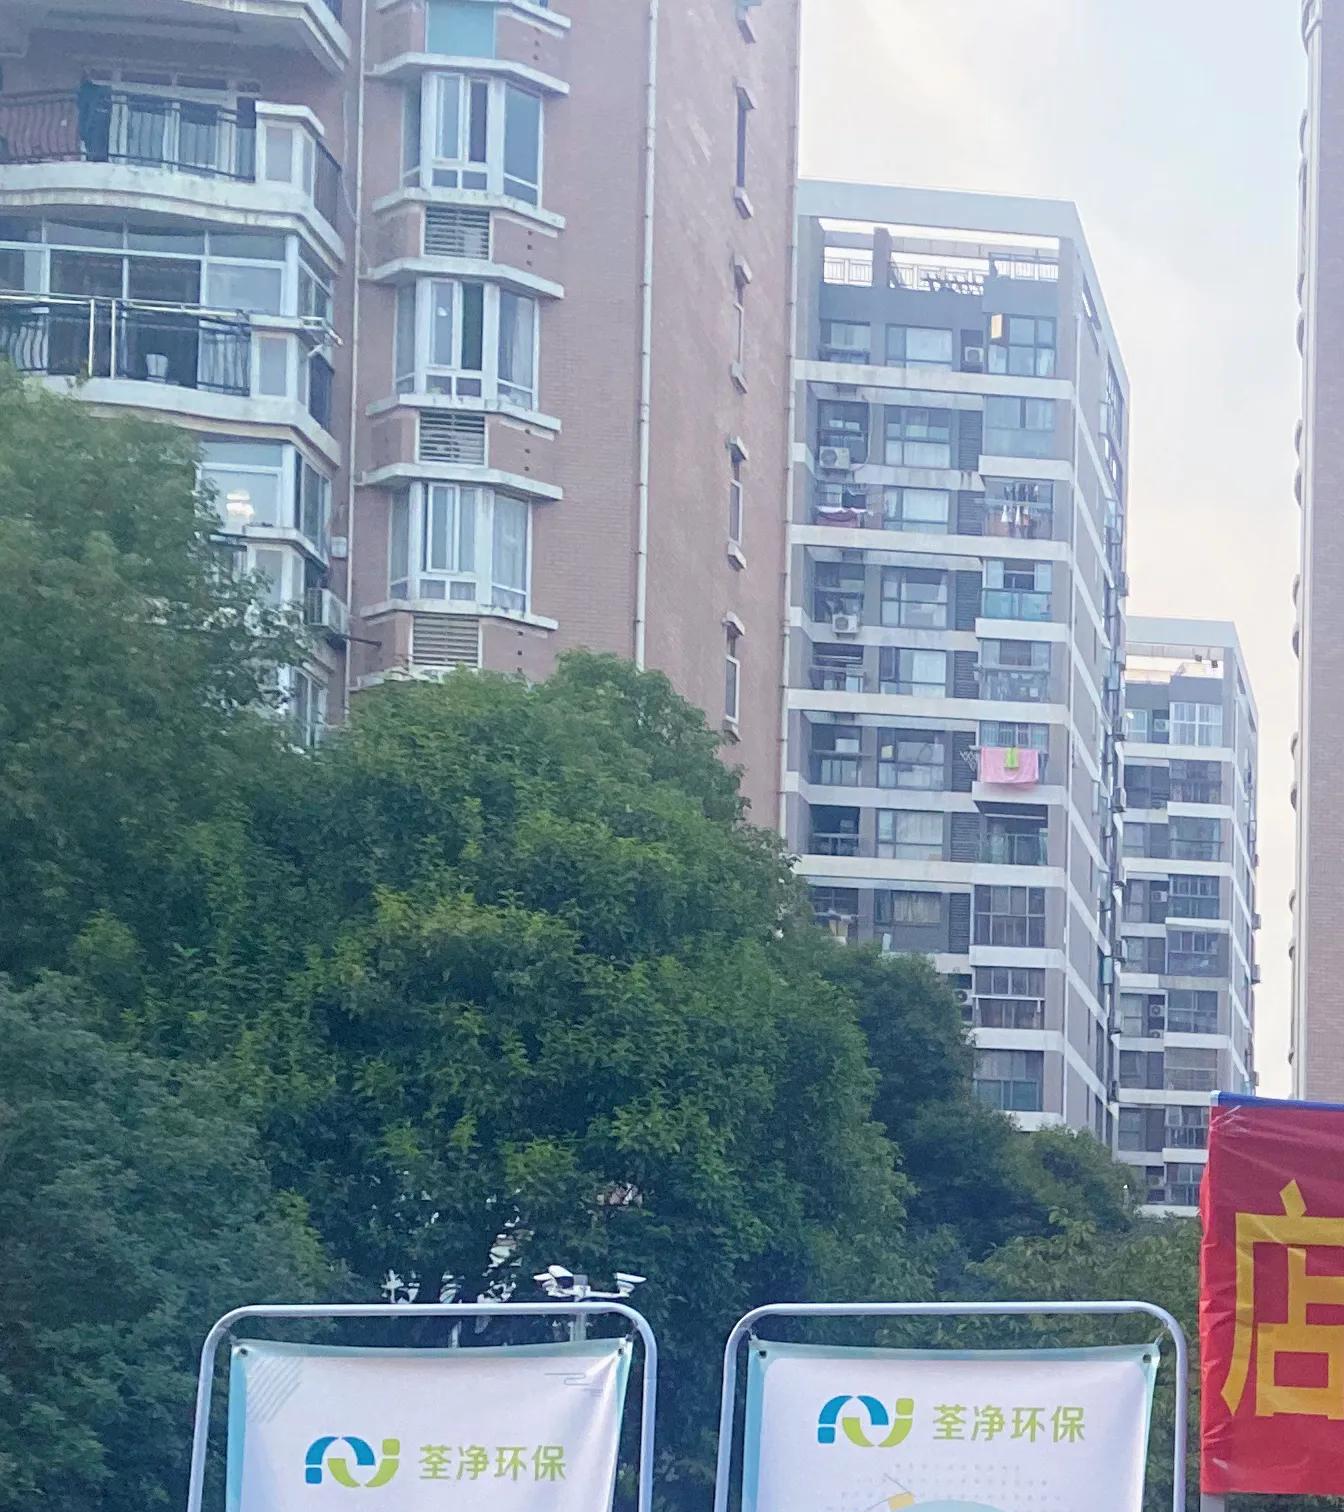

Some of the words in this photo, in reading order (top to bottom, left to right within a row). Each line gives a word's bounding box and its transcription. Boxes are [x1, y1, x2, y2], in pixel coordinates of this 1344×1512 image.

[931, 1404, 1086, 1444] 荃净环保
[419, 1442, 567, 1483] 荃净环保
